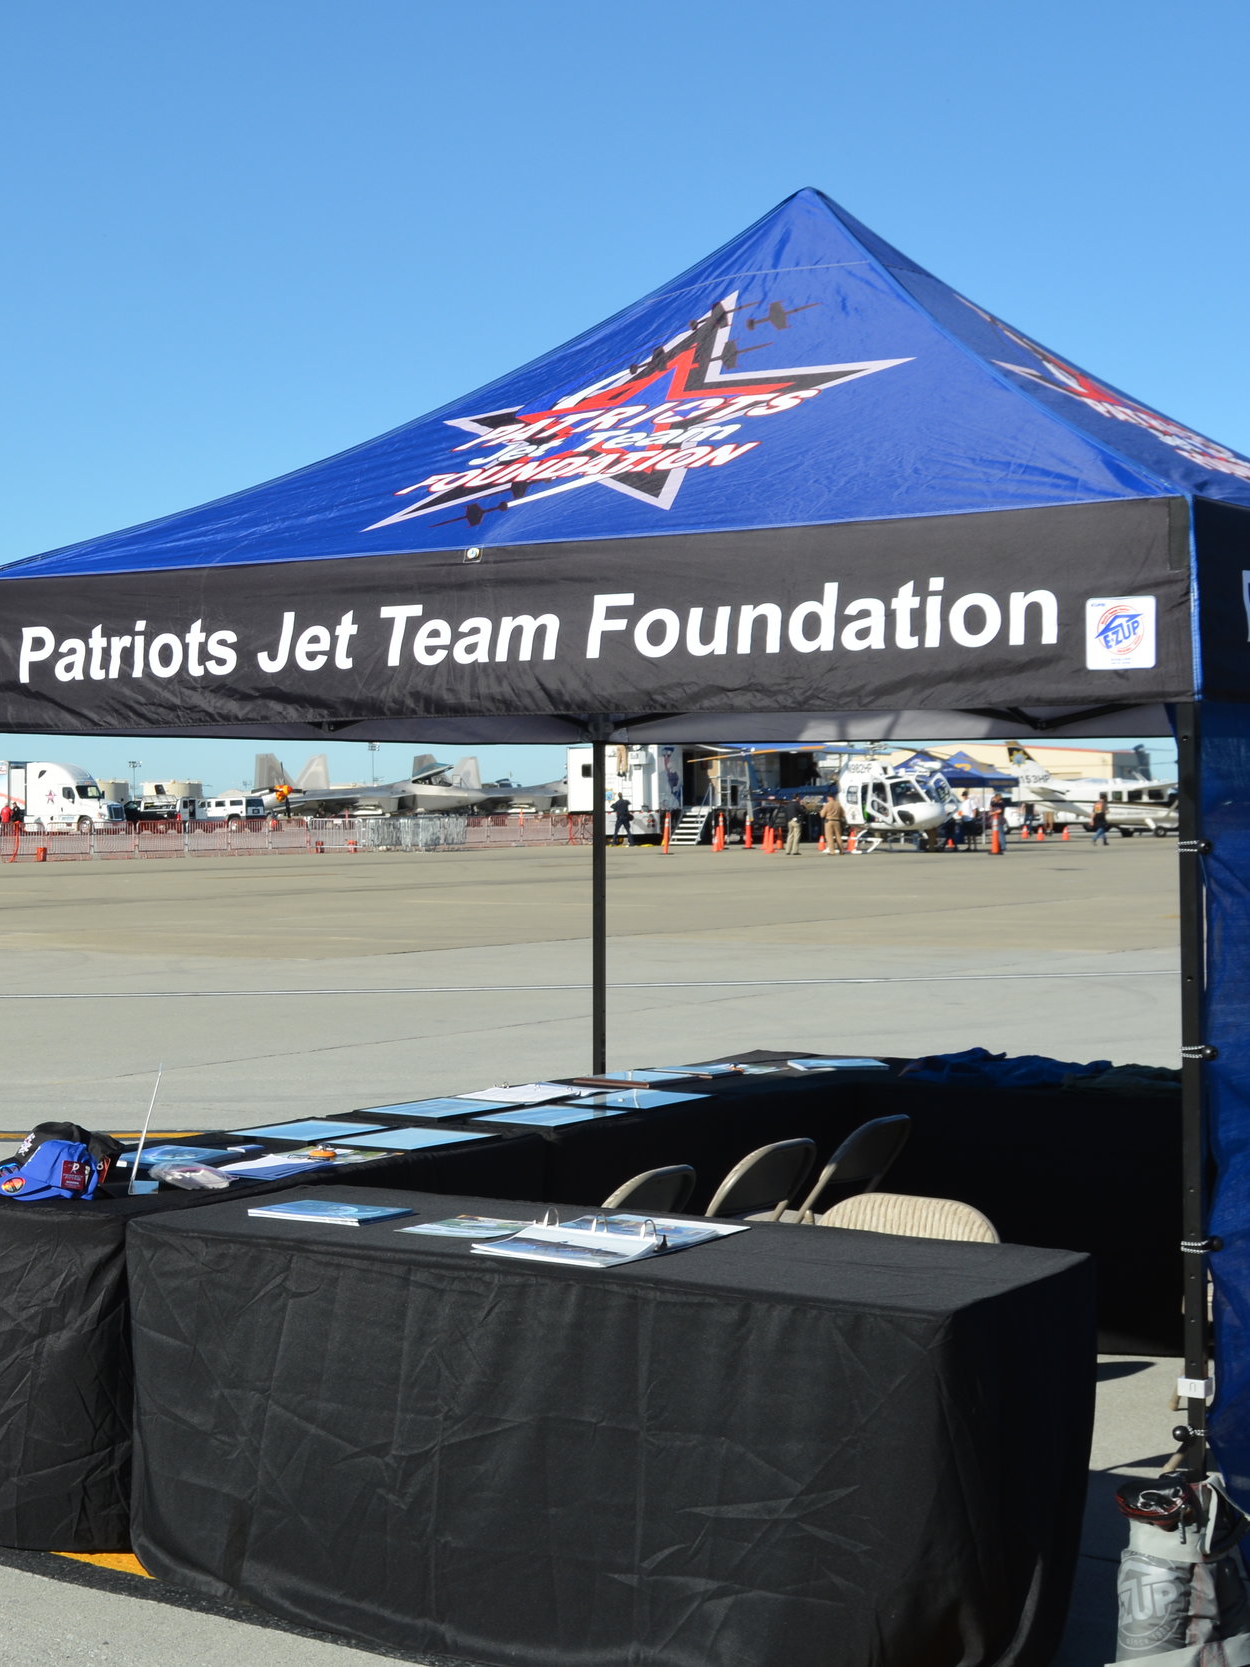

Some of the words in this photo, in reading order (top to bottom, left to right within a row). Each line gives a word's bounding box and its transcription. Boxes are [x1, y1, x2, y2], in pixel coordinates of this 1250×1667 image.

[450, 388, 821, 452] PATRIOTS
[467, 437, 567, 467] Jet
[572, 424, 743, 453] Team
[393, 441, 763, 496] FOUNDATION
[18, 619, 238, 684] Patriots
[256, 610, 359, 674] Jet
[379, 605, 561, 667] Team
[585, 577, 1059, 659] Foundation
